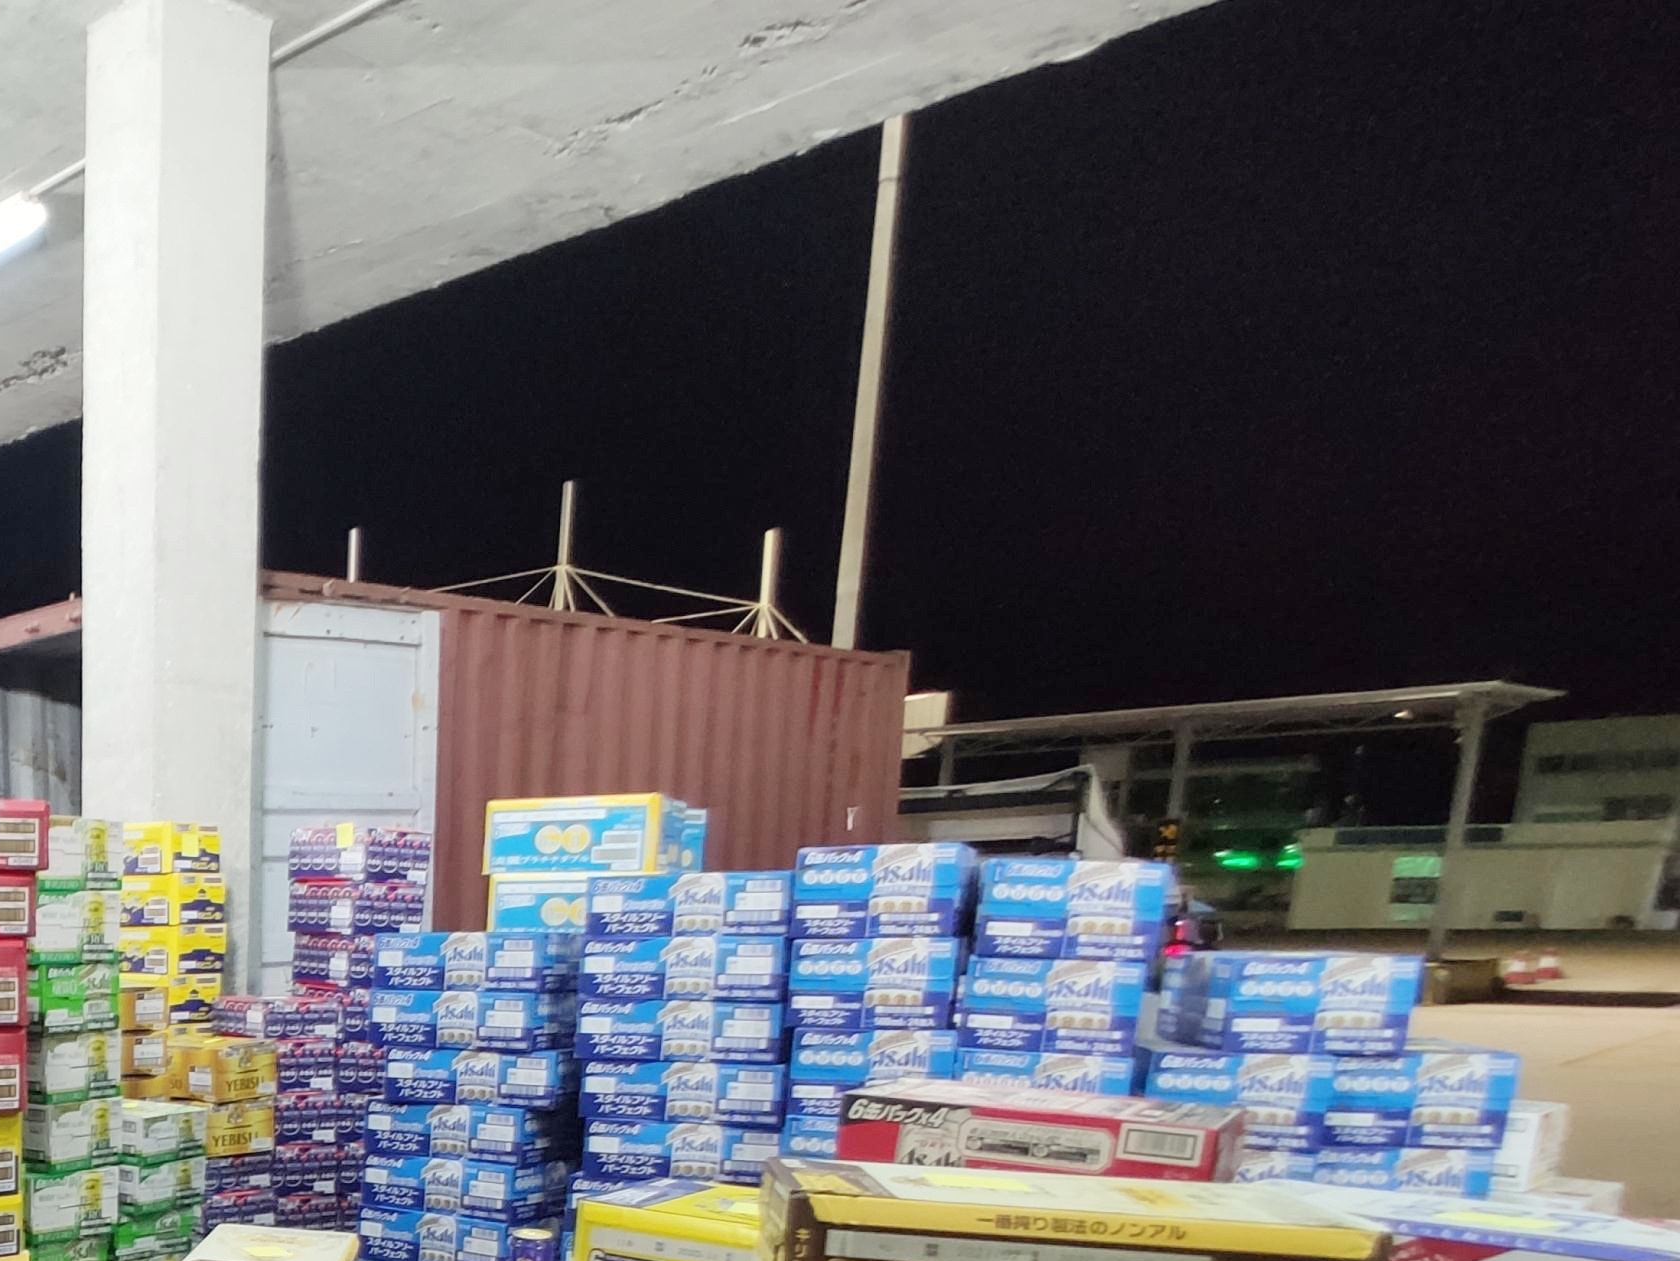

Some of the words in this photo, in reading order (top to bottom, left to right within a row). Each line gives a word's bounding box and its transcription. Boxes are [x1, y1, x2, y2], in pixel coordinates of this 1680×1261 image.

[875, 862, 932, 884] Asahi
[680, 887, 722, 906] Asahi
[448, 947, 483, 962] Asahi
[670, 951, 712, 968] Asahi
[870, 954, 928, 976] Asahi
[440, 1005, 474, 1021] Asahi
[667, 1014, 711, 1032] Asahi
[871, 1046, 927, 1068] Asahi
[459, 1061, 496, 1078] Asahi
[671, 1076, 714, 1093] Asahi
[432, 1117, 466, 1133] Asahi
[674, 1137, 718, 1154] Asahi
[428, 1173, 460, 1188] Asahi
